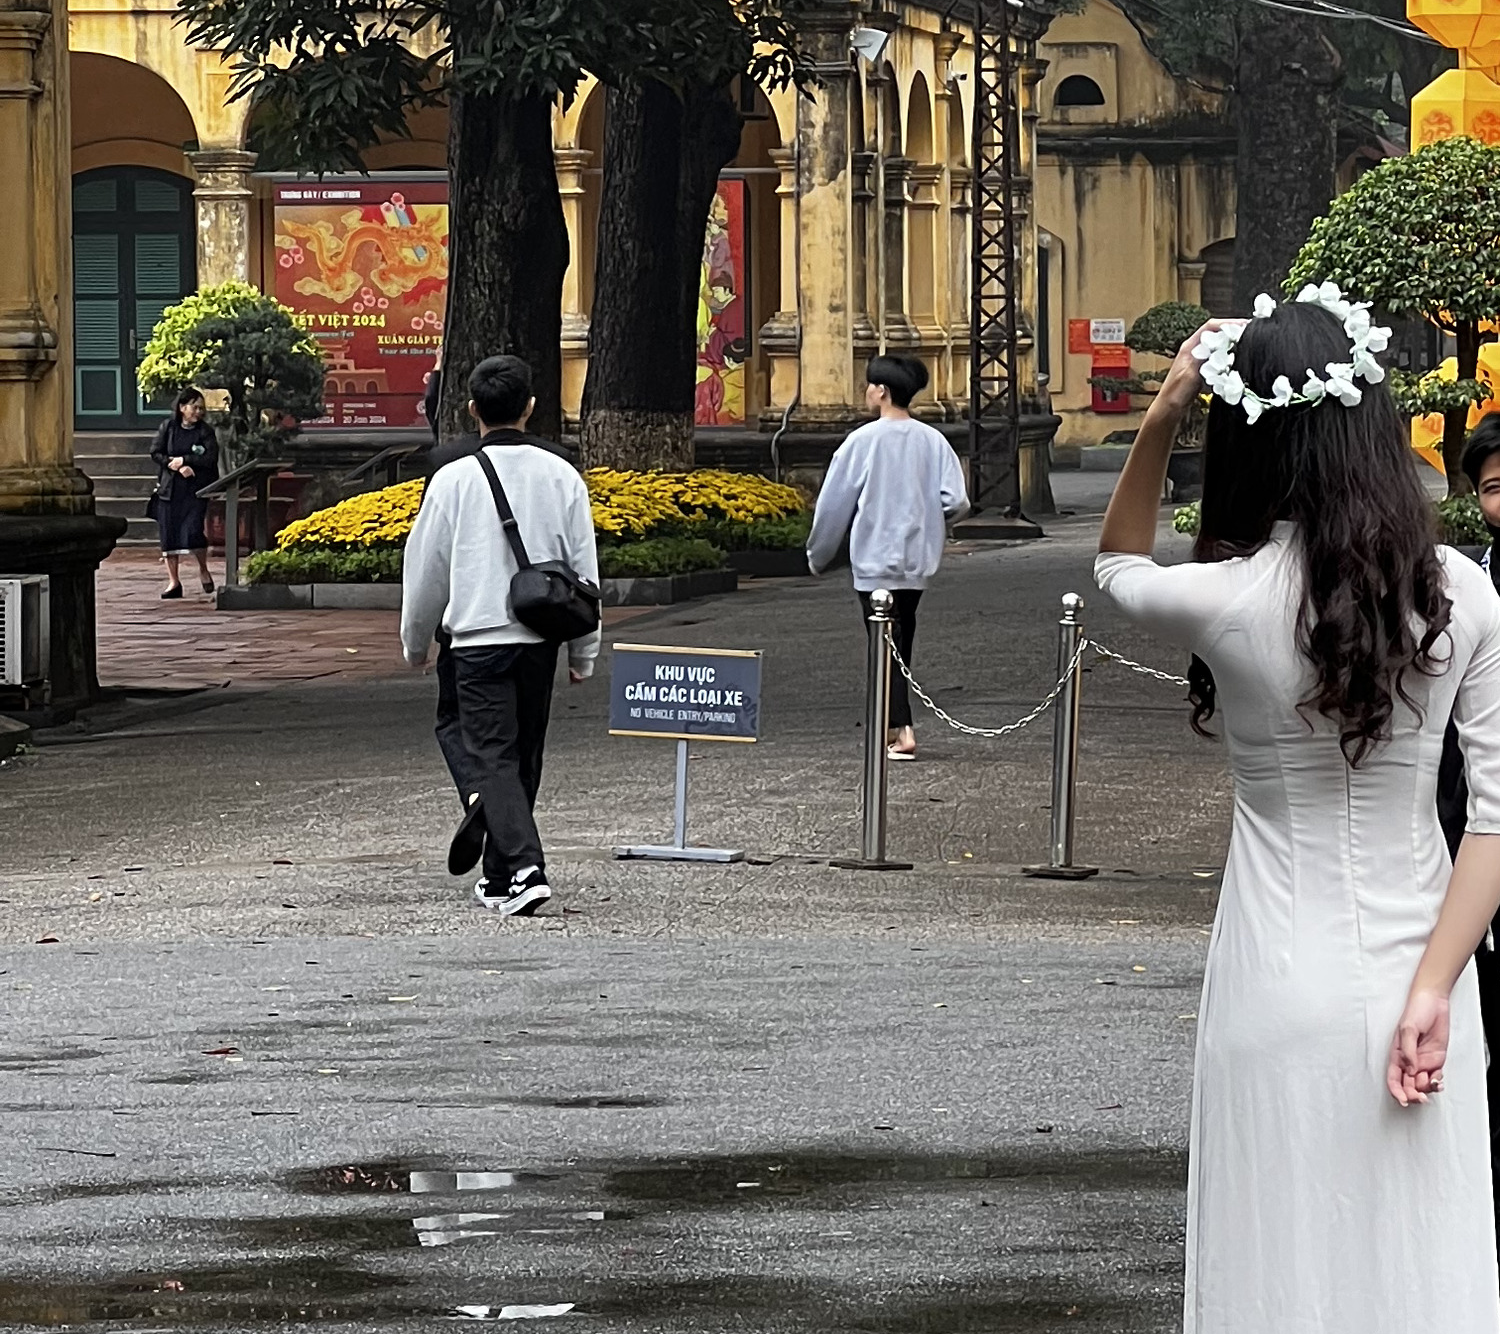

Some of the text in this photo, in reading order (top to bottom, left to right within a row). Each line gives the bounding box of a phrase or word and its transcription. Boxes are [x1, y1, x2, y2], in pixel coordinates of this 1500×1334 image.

[352, 313, 386, 327] 2024
[655, 664, 716, 686] KHU VỰC
[625, 681, 743, 708] CẤM CÁC LOẠI XE
[630, 707, 642, 718] NO
[644, 708, 675, 720] VEHICLE
